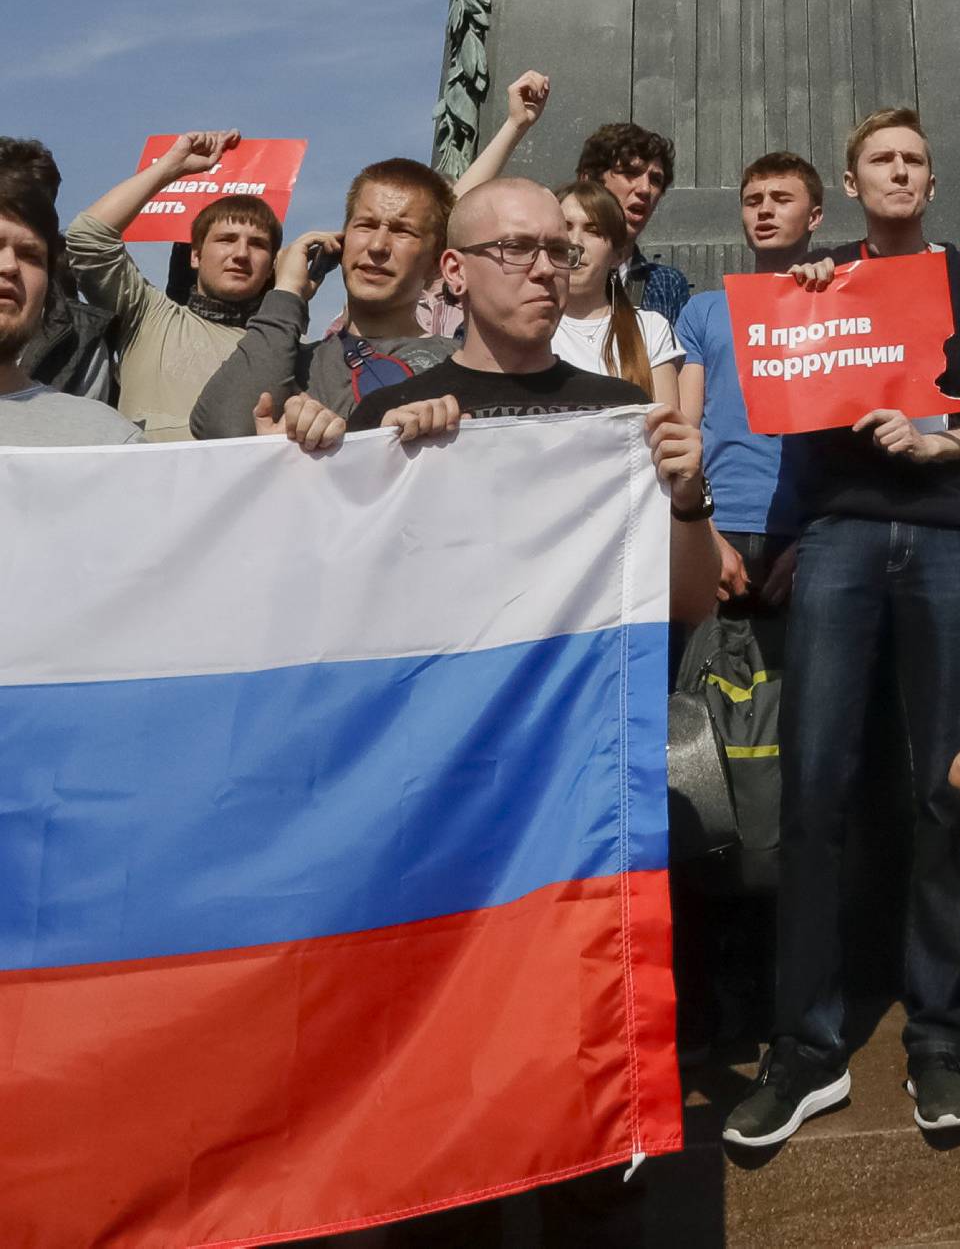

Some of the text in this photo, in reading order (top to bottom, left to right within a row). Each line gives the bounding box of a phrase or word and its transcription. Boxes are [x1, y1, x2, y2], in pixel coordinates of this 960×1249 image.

[159, 181, 266, 195] шать нам
[748, 317, 872, 349] Я против
[752, 345, 904, 381] коррупции
